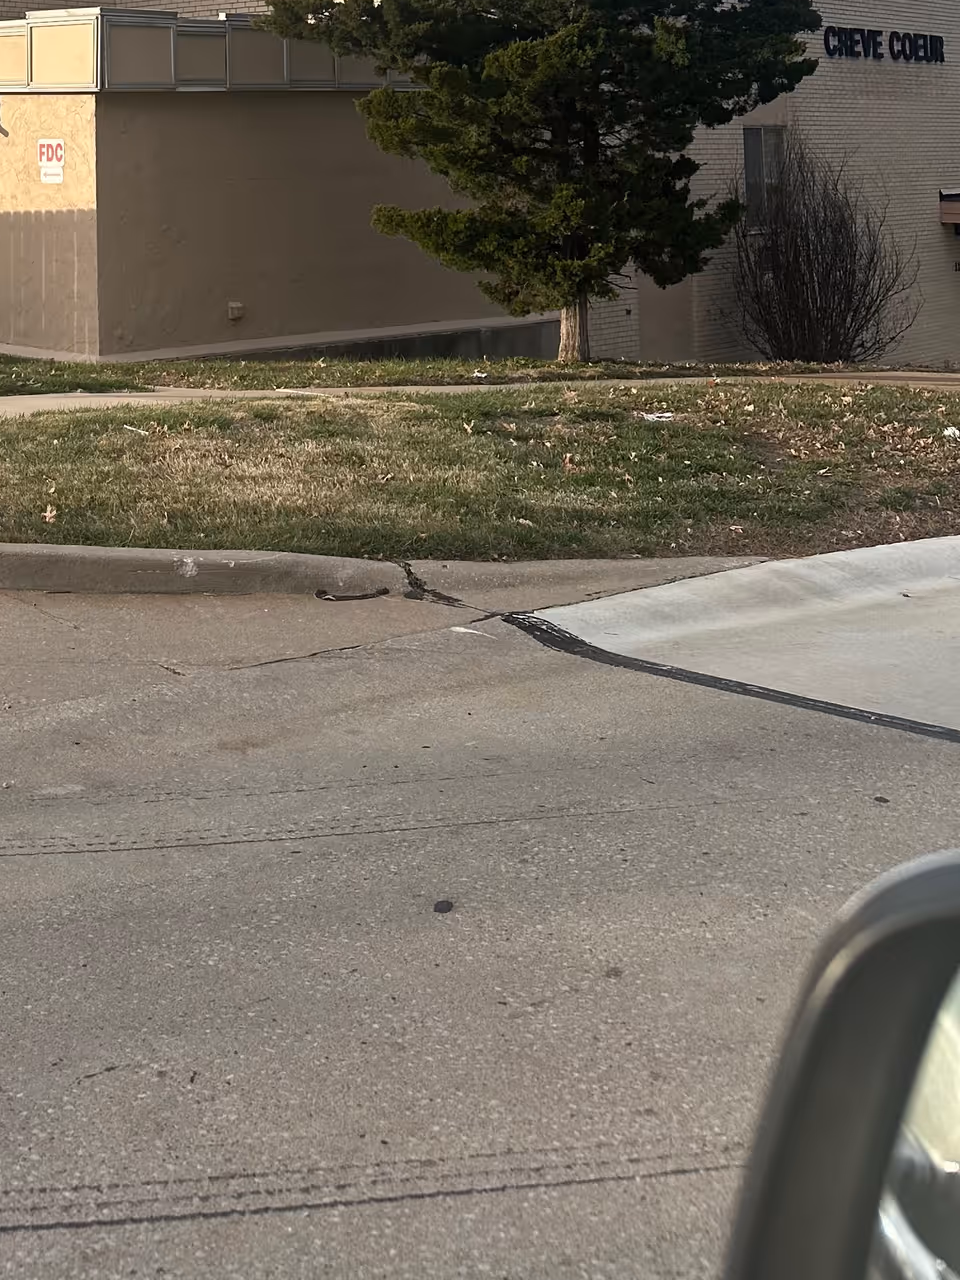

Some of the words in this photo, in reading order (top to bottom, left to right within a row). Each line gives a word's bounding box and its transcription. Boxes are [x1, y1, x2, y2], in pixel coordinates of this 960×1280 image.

[824, 26, 884, 59] CREVE
[889, 31, 944, 62] COEUR
[39, 143, 63, 162] FDC
